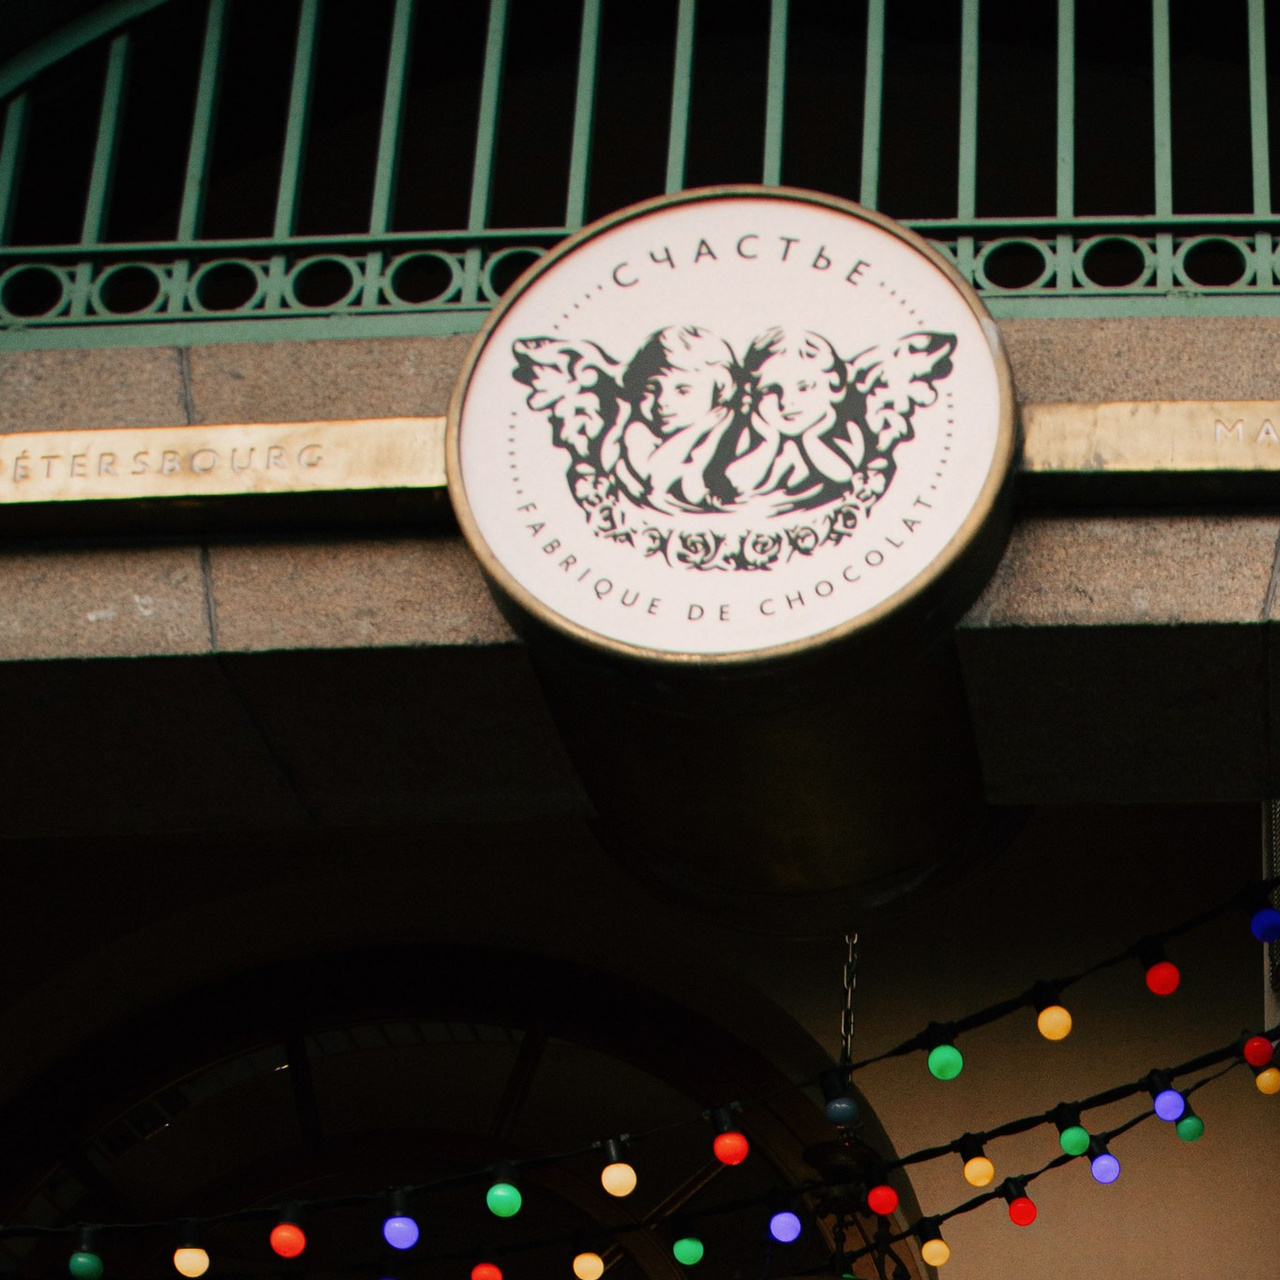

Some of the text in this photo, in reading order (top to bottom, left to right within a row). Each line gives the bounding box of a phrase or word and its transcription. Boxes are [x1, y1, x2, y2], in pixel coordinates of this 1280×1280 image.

[611, 233, 870, 289] СЧАСТЬЕ
[4, 443, 325, 483] ÉTERSBOURG
[516, 494, 933, 622] FABRIQUE DE CHOCOLAT
